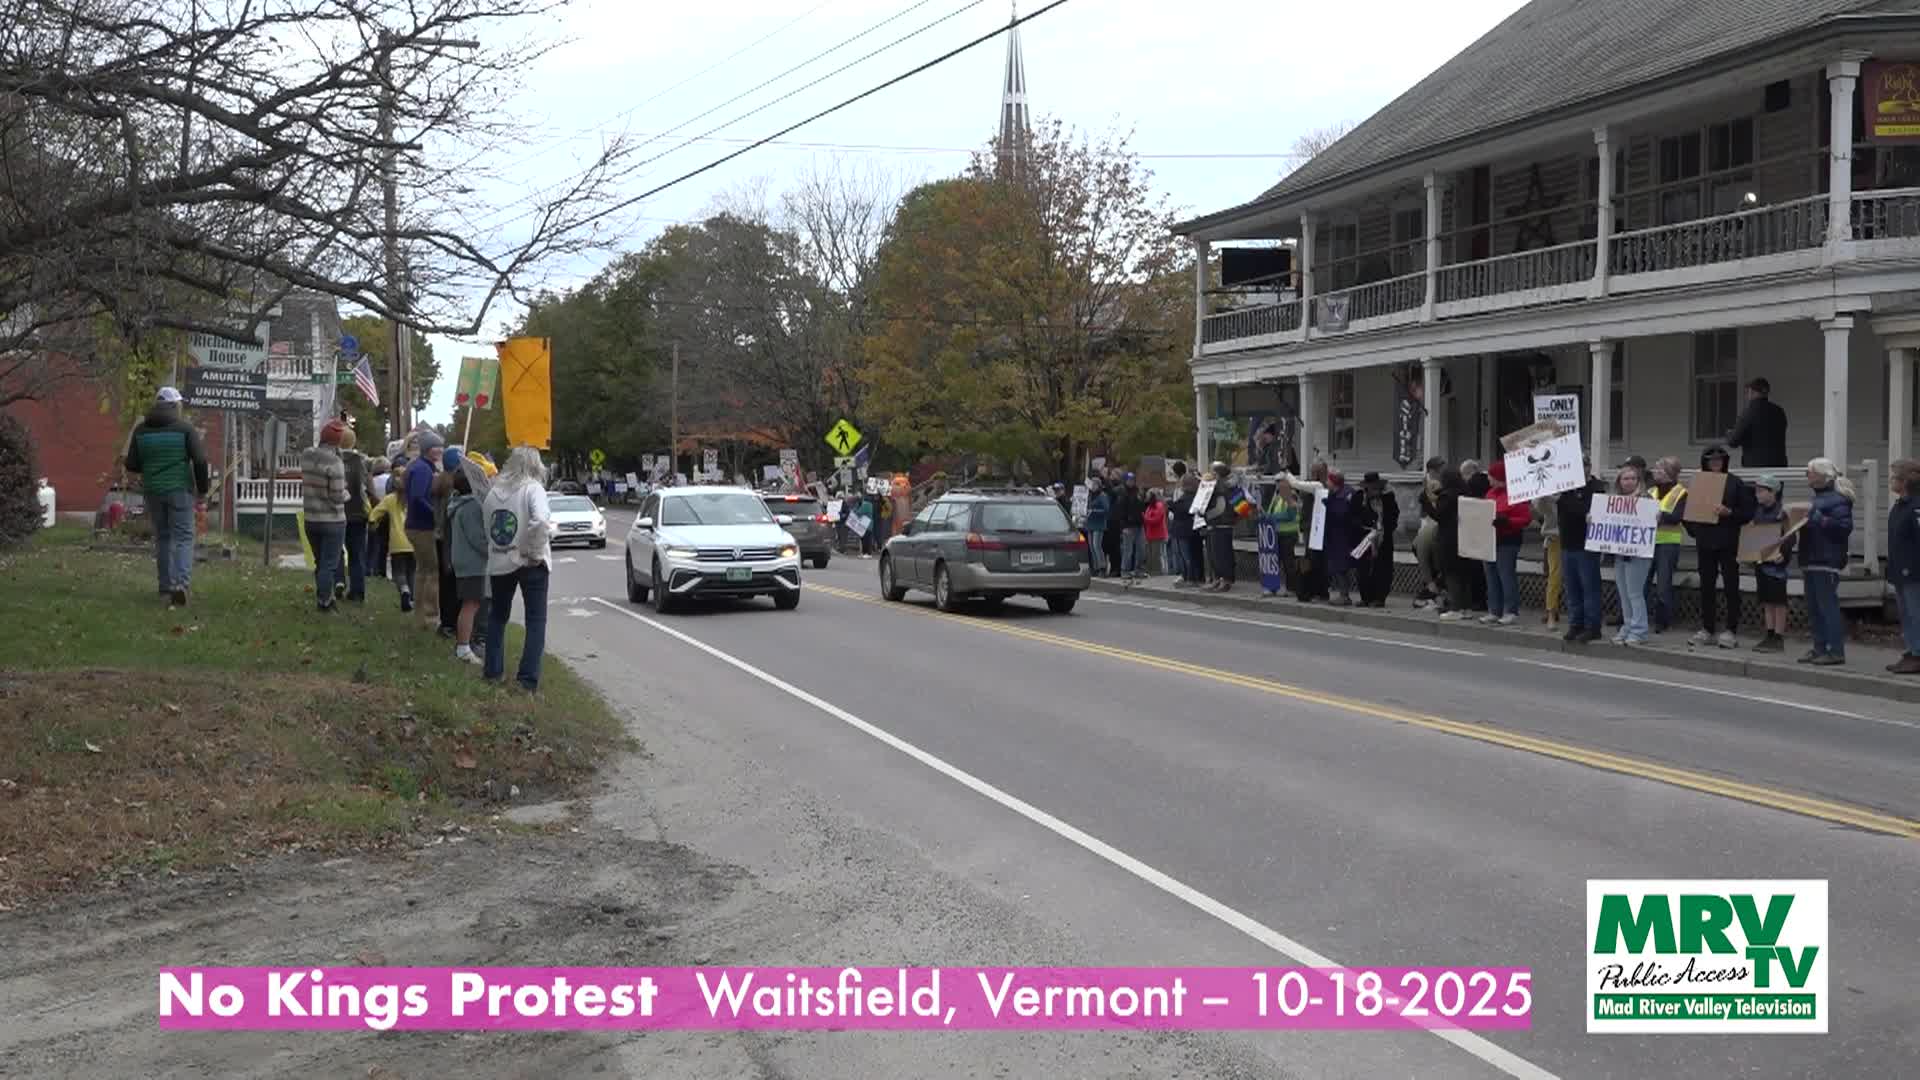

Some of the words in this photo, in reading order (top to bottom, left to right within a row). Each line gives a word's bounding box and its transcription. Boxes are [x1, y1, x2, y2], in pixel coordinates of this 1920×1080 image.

[209, 350, 247, 364] House
[195, 387, 256, 399] UNIVERSAL
[220, 399, 260, 409] SYSTEMS
[1550, 398, 1575, 411] ONLY
[1606, 496, 1640, 515] HONK
[1258, 522, 1275, 549] NO
